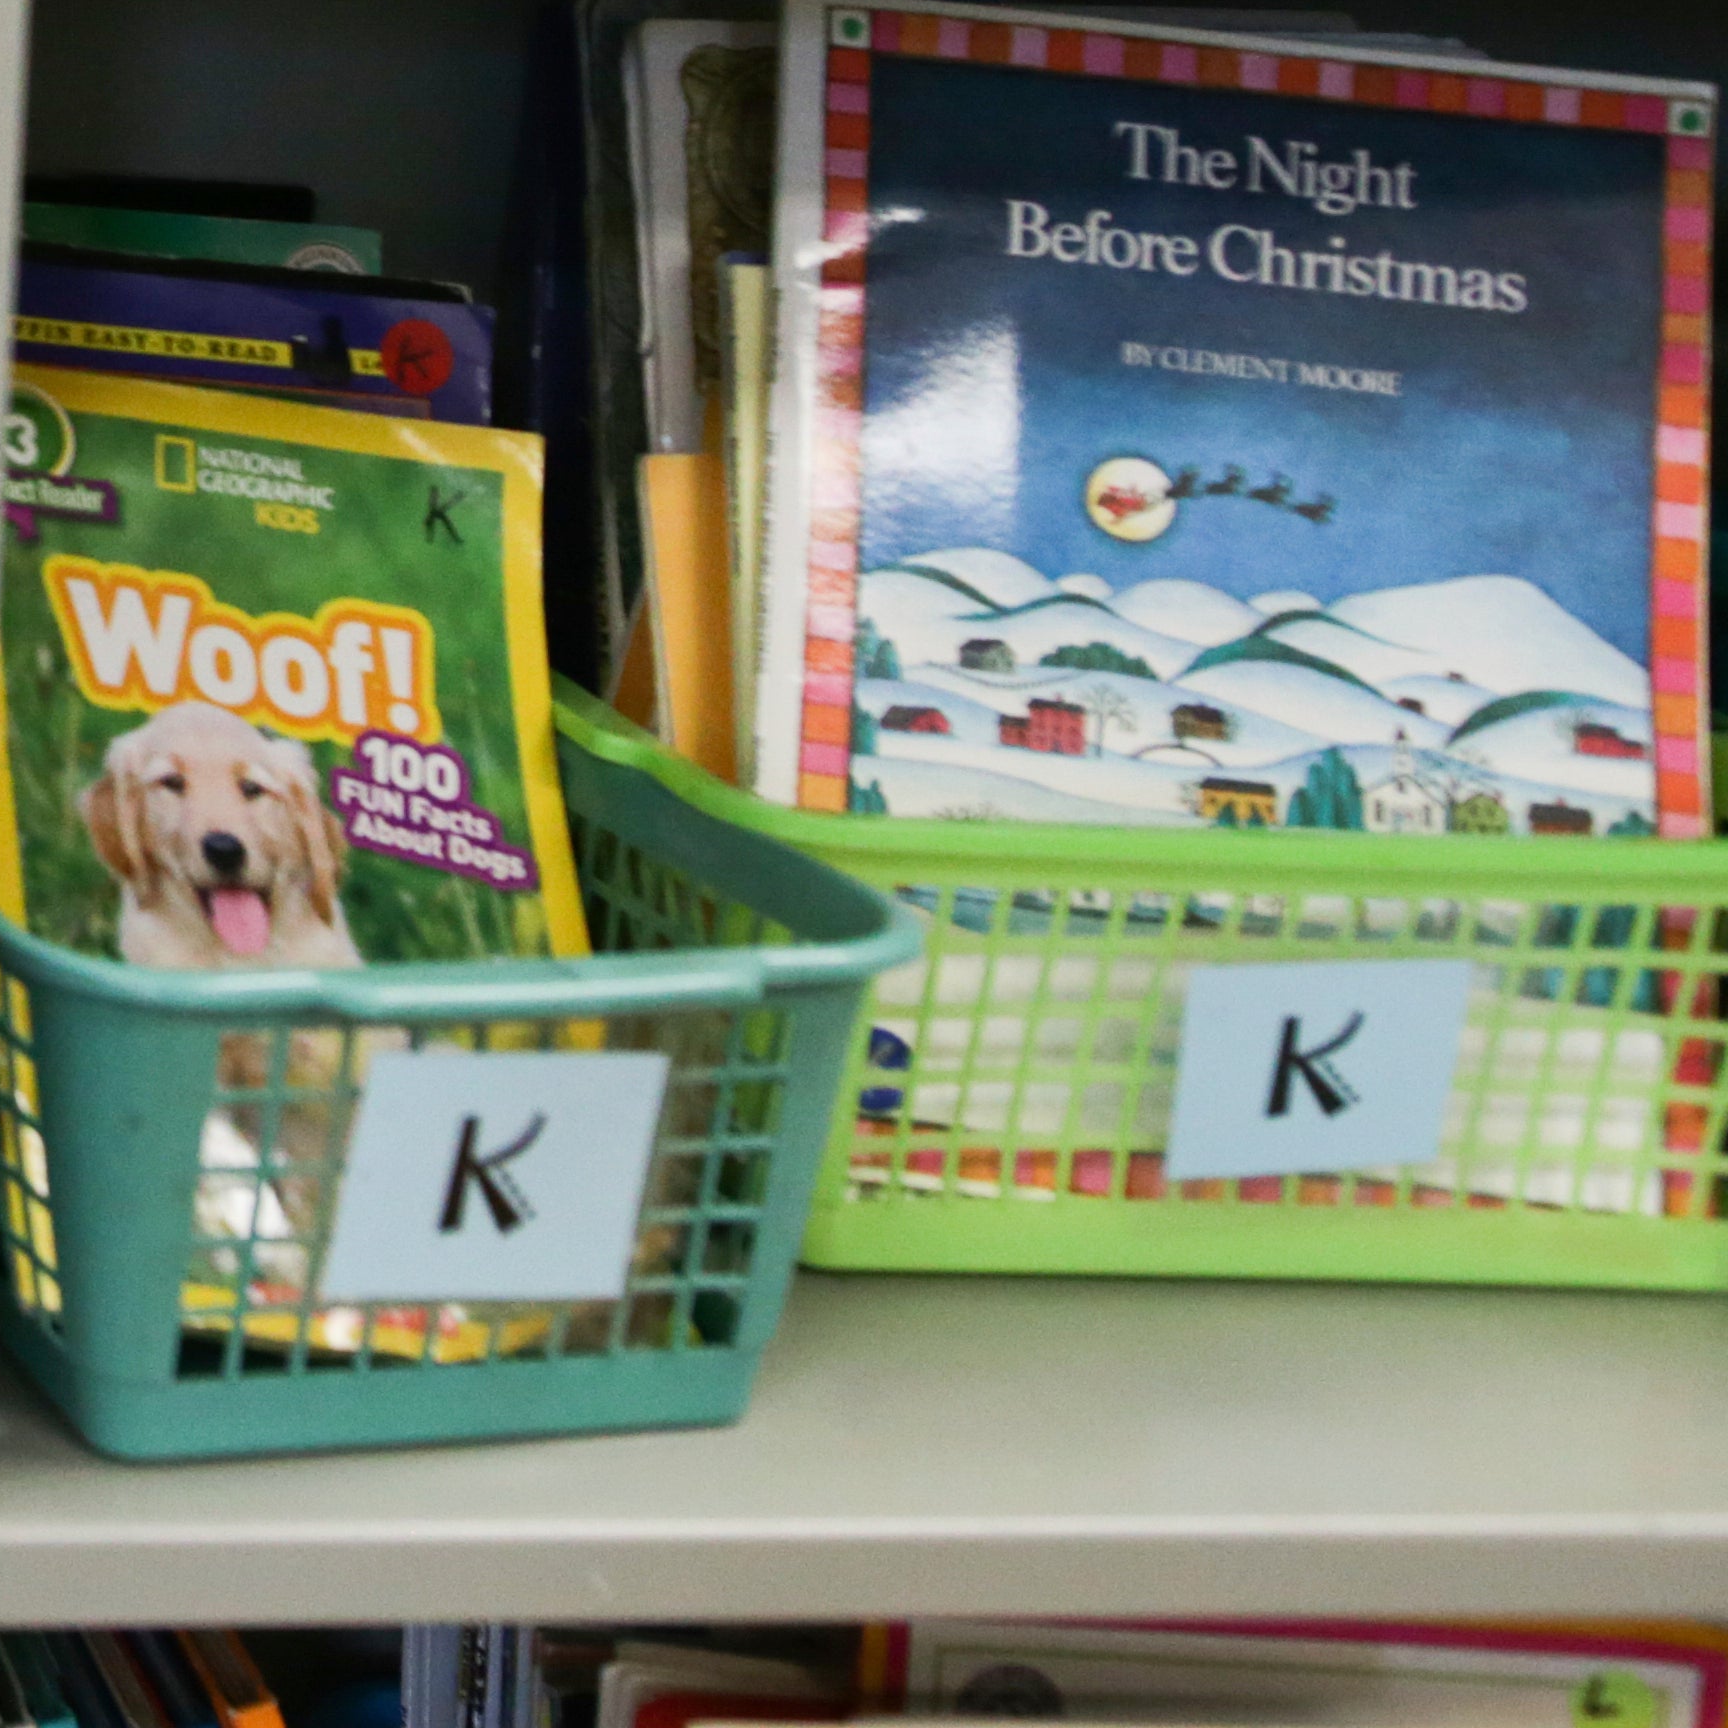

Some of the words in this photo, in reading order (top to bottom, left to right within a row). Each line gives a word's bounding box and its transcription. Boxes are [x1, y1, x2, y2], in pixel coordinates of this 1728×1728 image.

[1114, 121, 1238, 189] The
[1247, 137, 1418, 214] Night
[1006, 199, 1198, 275] Before
[1210, 224, 1528, 313] Christmas
[1121, 341, 1155, 367] BY
[1161, 346, 1299, 383] CLEMENT
[1299, 364, 1403, 396] MOORE
[3, 415, 37, 465] 3
[254, 502, 320, 534] KIDS
[425, 485, 465, 543] K
[66, 578, 421, 731] Woof!
[362, 737, 460, 801] 100
[338, 777, 405, 819] FUN
[409, 795, 492, 841] Facts
[352, 813, 444, 859] About
[448, 835, 527, 880] Dogs
[1263, 1011, 1365, 1117] K
[437, 1113, 547, 1233] K
